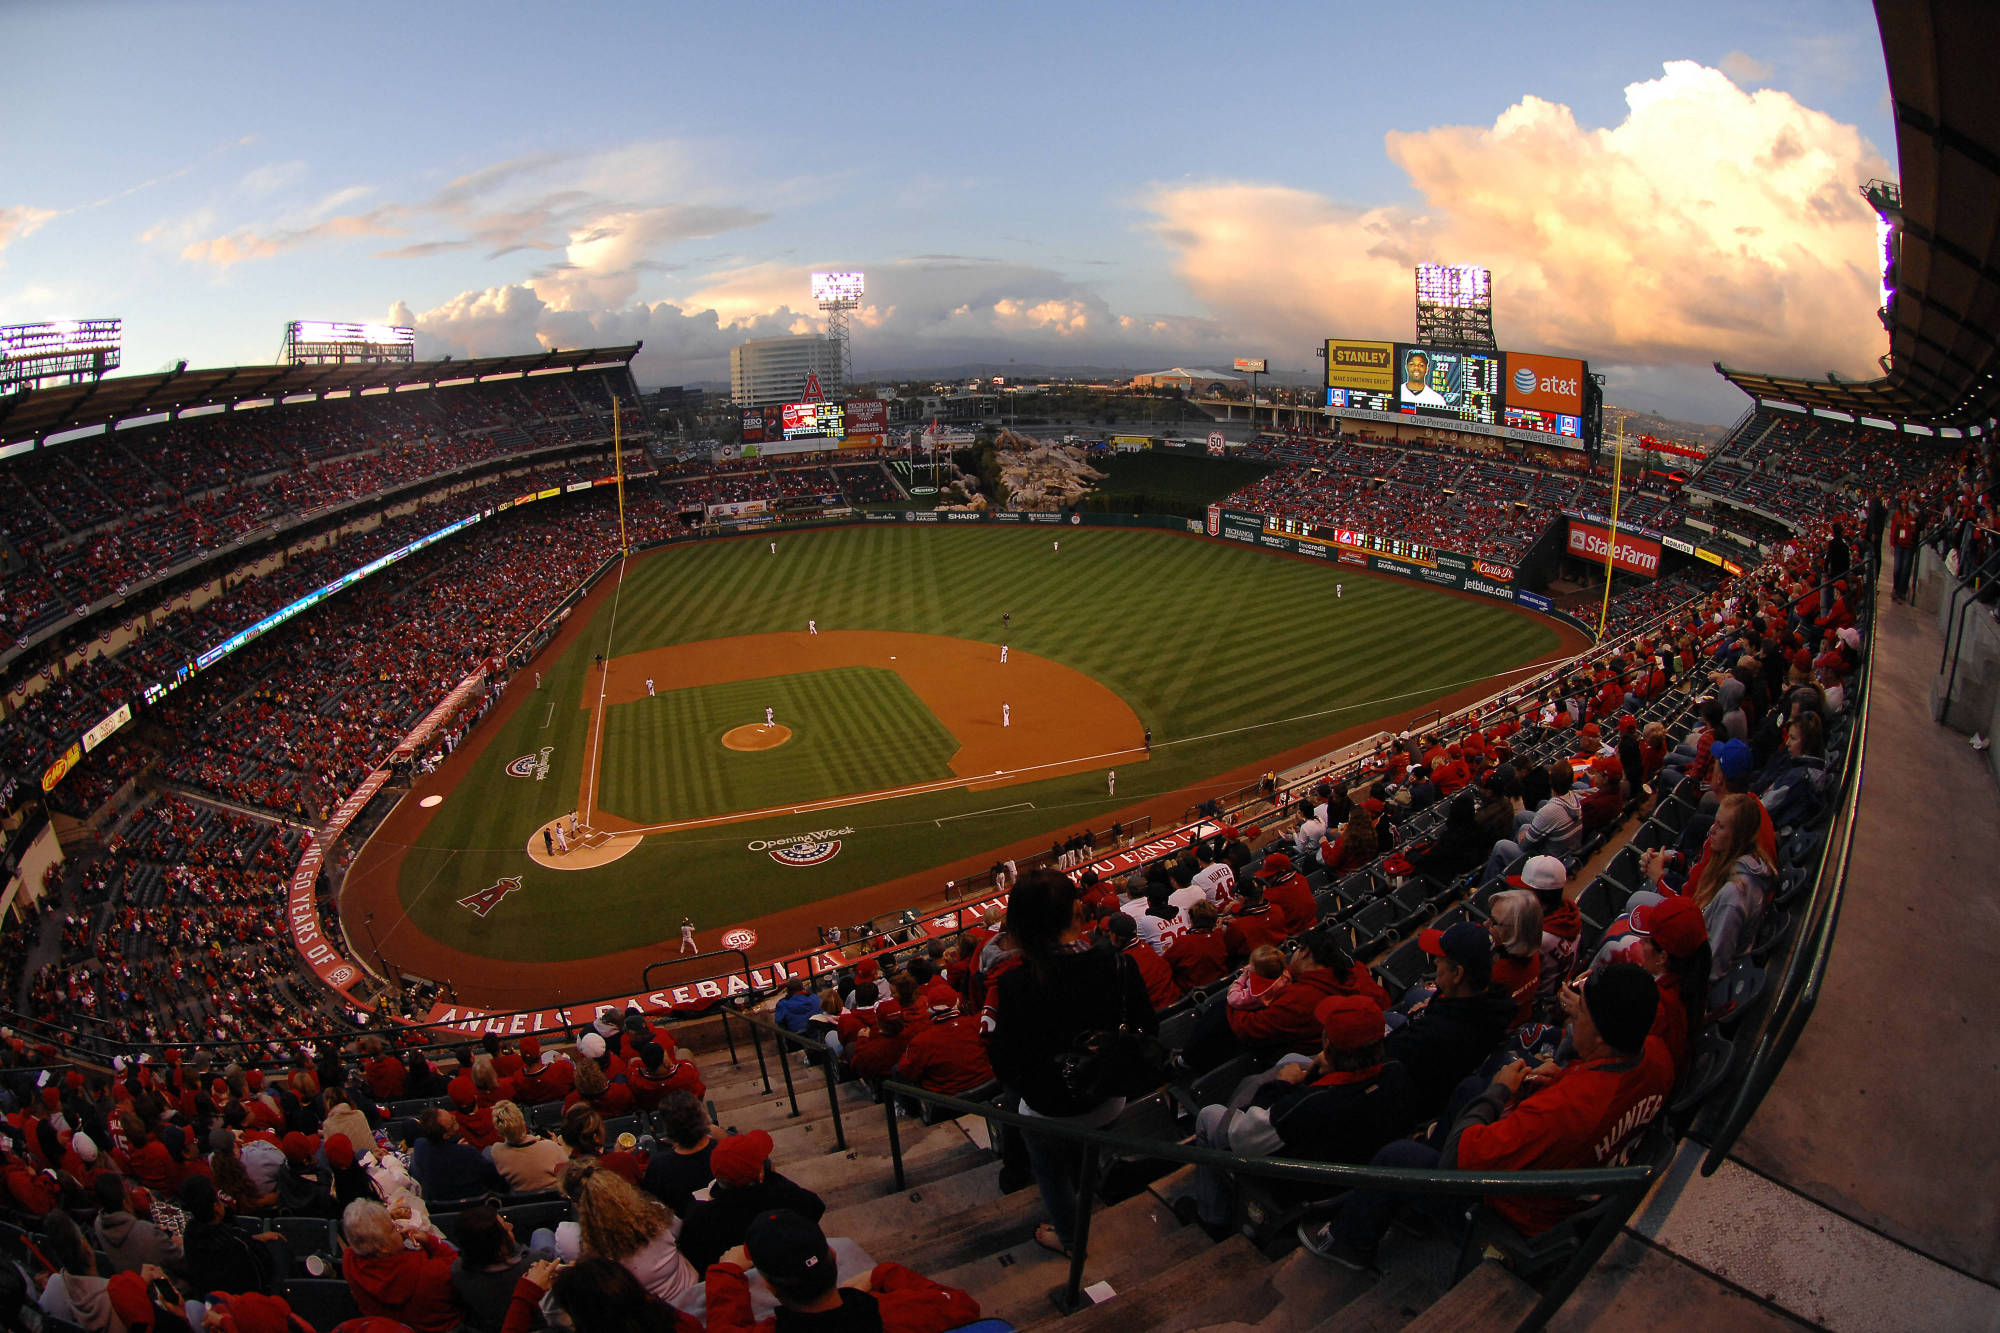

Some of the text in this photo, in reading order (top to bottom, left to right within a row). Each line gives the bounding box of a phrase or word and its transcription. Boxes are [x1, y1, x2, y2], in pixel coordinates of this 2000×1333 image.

[1337, 350, 1386, 364] STANLEY
[1436, 363, 1449, 372] 222
[1346, 376, 1373, 384] SOMETHING
[1540, 376, 1577, 396] at&t
[743, 417, 762, 425] ZERO
[1341, 409, 1390, 421] OneWest Bank
[1410, 415, 1426, 425] One
[1427, 417, 1451, 429] Person
[1452, 420, 1462, 430] at
[1469, 421, 1490, 434] Time
[1210, 437, 1222, 447] 50
[1510, 429, 1567, 446] OneWest Bank
[1225, 527, 1254, 538] PECHANGA
[1585, 535, 1656, 570] State Farm
[1665, 538, 1691, 553] KOMATSU
[1377, 562, 1397, 571] SAFARI
[1396, 566, 1411, 575] PARK
[1430, 569, 1457, 581] HYUNDAI
[1463, 578, 1513, 600] jetblue.com
[747, 825, 856, 851] Opening Week
[1119, 839, 1178, 865] FANS
[291, 783, 377, 966] CELEBRATING 50 YEARS OF
[1208, 866, 1231, 884] HUNTER
[1157, 915, 1183, 932] CAREW
[730, 934, 748, 944] 50
[437, 961, 799, 1034] ANGELS BASEBALL
[1594, 1094, 1663, 1162] HUNTER
